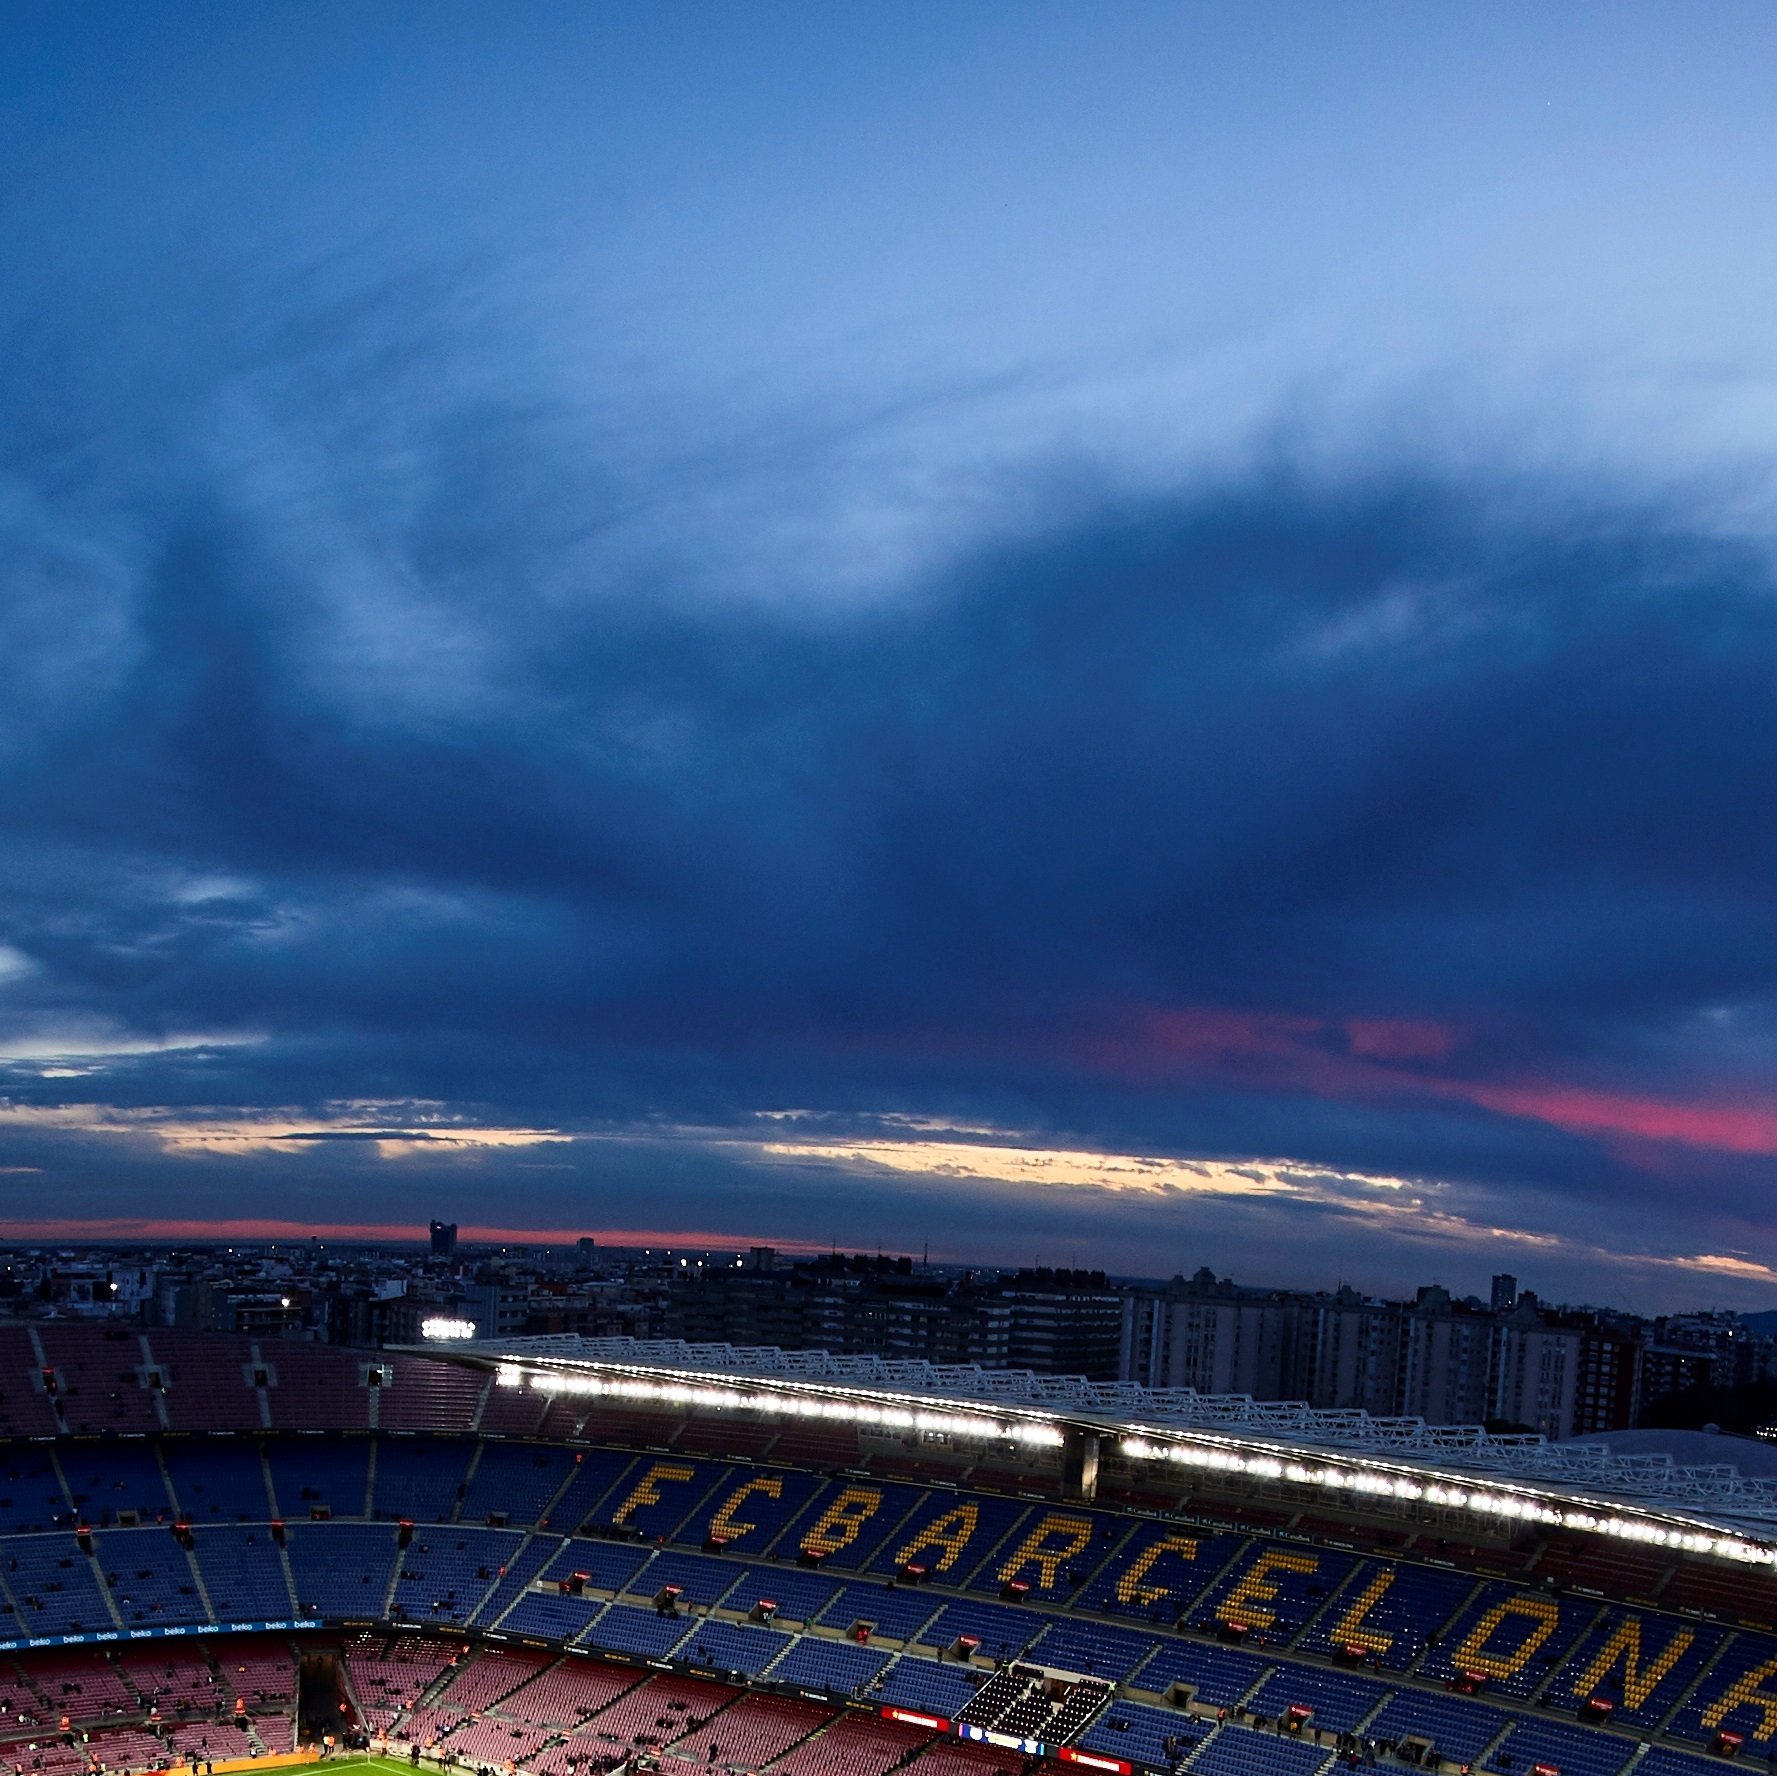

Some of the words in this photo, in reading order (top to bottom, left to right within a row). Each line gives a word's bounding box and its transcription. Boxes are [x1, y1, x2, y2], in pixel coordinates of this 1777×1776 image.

[30, 1638, 50, 1646] beko
[63, 1635, 84, 1643] beko
[97, 1632, 117, 1640] beko
[130, 1630, 151, 1638] beko
[164, 1626, 185, 1635] beko
[198, 1624, 218, 1633] beko
[231, 1622, 252, 1631] beko
[265, 1621, 286, 1629] beko
[294, 1620, 315, 1628] beko
